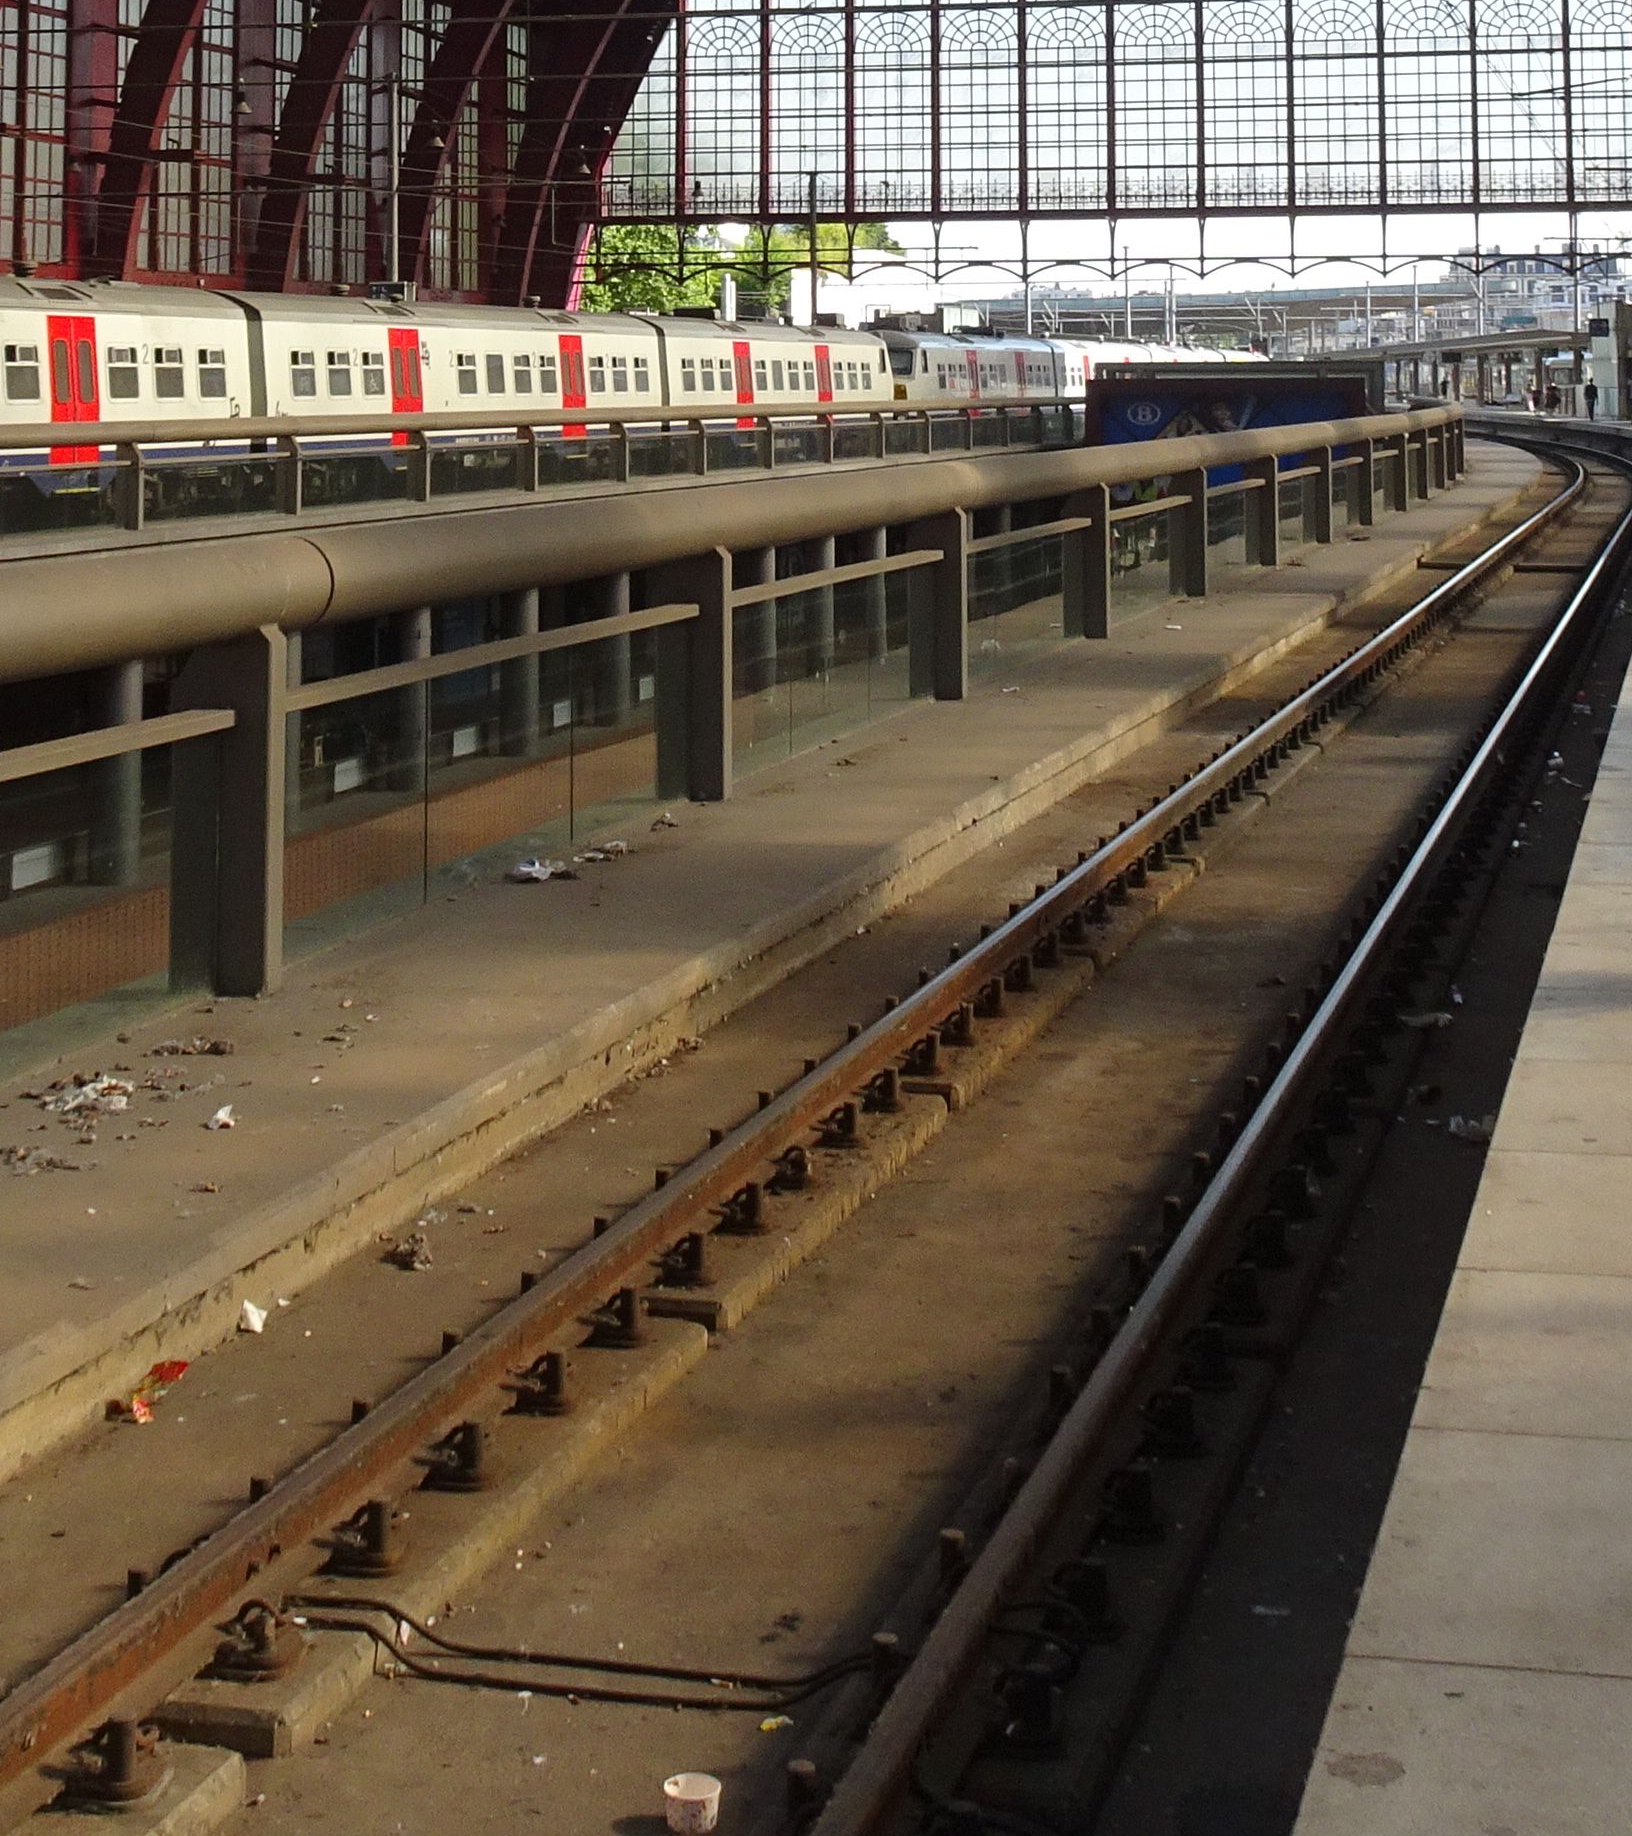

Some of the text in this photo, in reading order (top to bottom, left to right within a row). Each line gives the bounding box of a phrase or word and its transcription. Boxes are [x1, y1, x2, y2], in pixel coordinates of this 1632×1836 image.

[142, 343, 150, 365] 2
[352, 348, 359, 367] 2
[448, 349, 455, 368] 2
